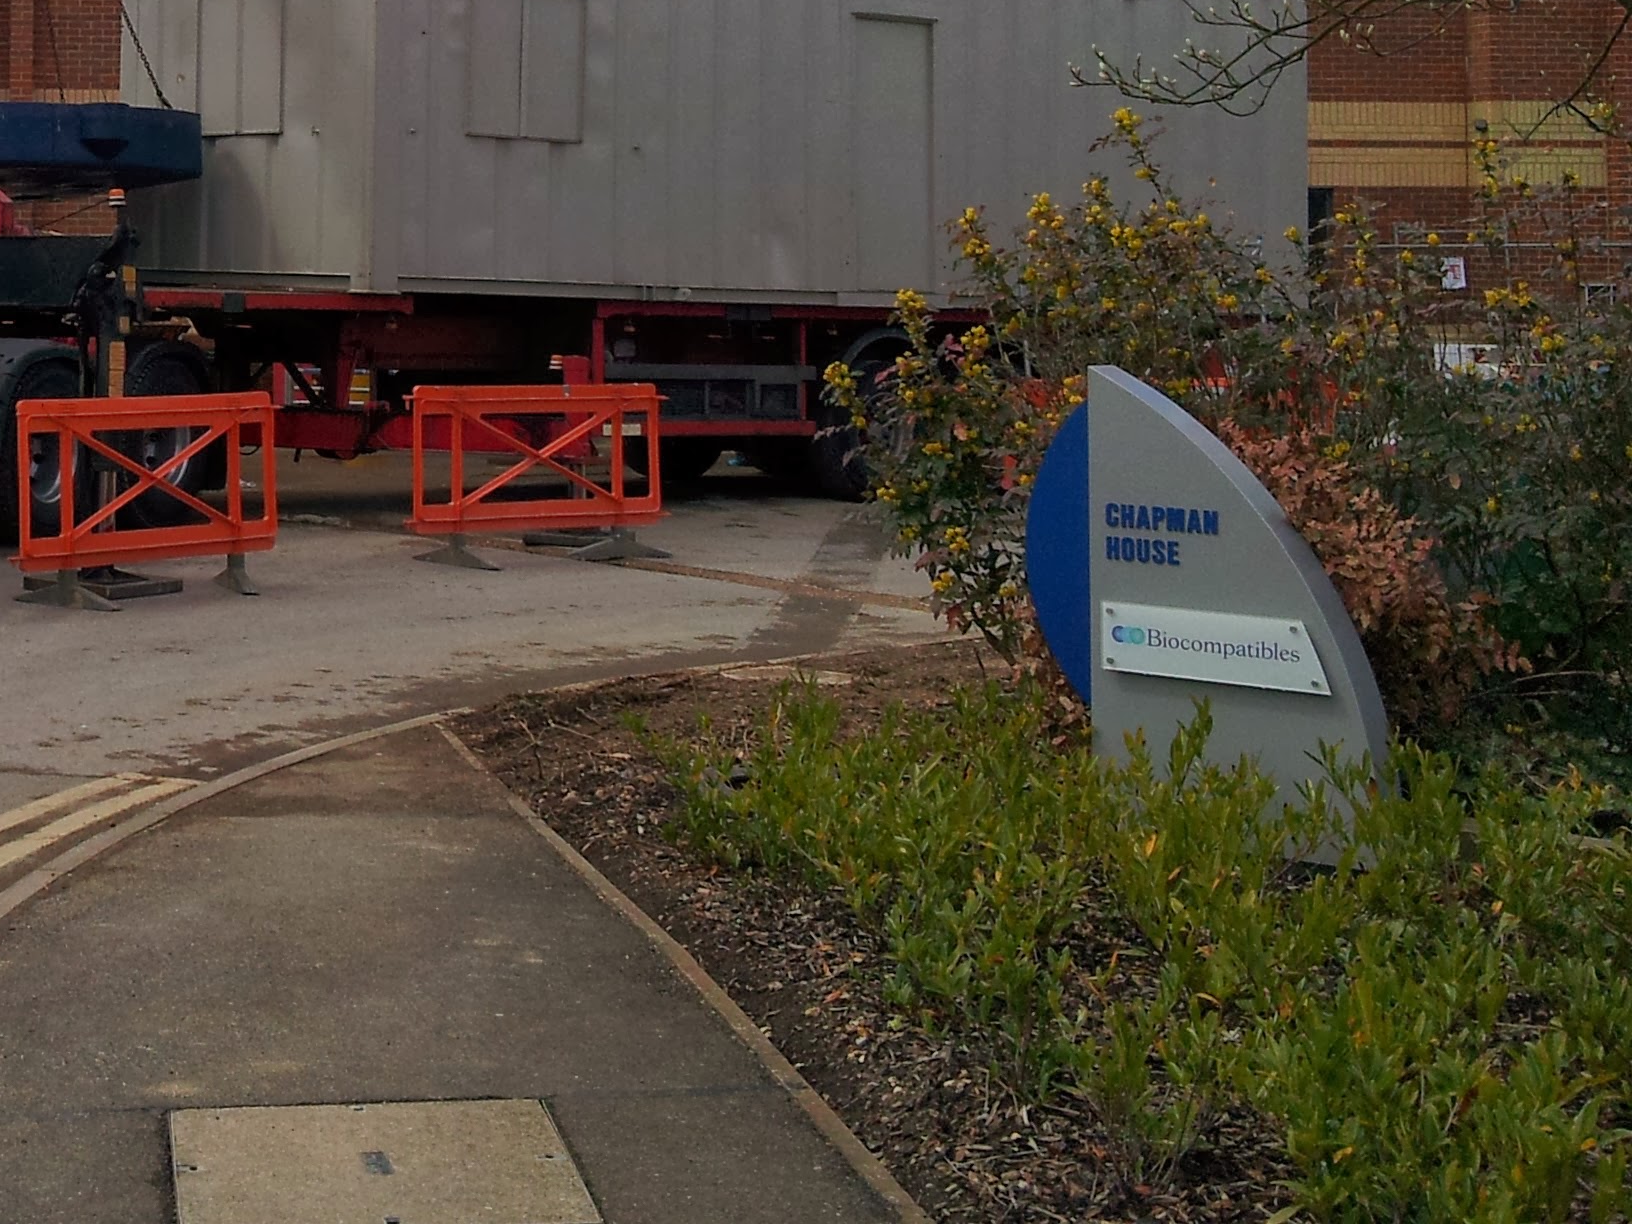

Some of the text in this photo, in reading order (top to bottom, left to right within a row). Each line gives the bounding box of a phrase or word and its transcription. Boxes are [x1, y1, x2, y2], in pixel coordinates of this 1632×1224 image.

[1105, 502, 1220, 536] CHAPMAN
[1105, 536, 1181, 566] HOUSE
[1147, 628, 1301, 663] Biocompatibles
